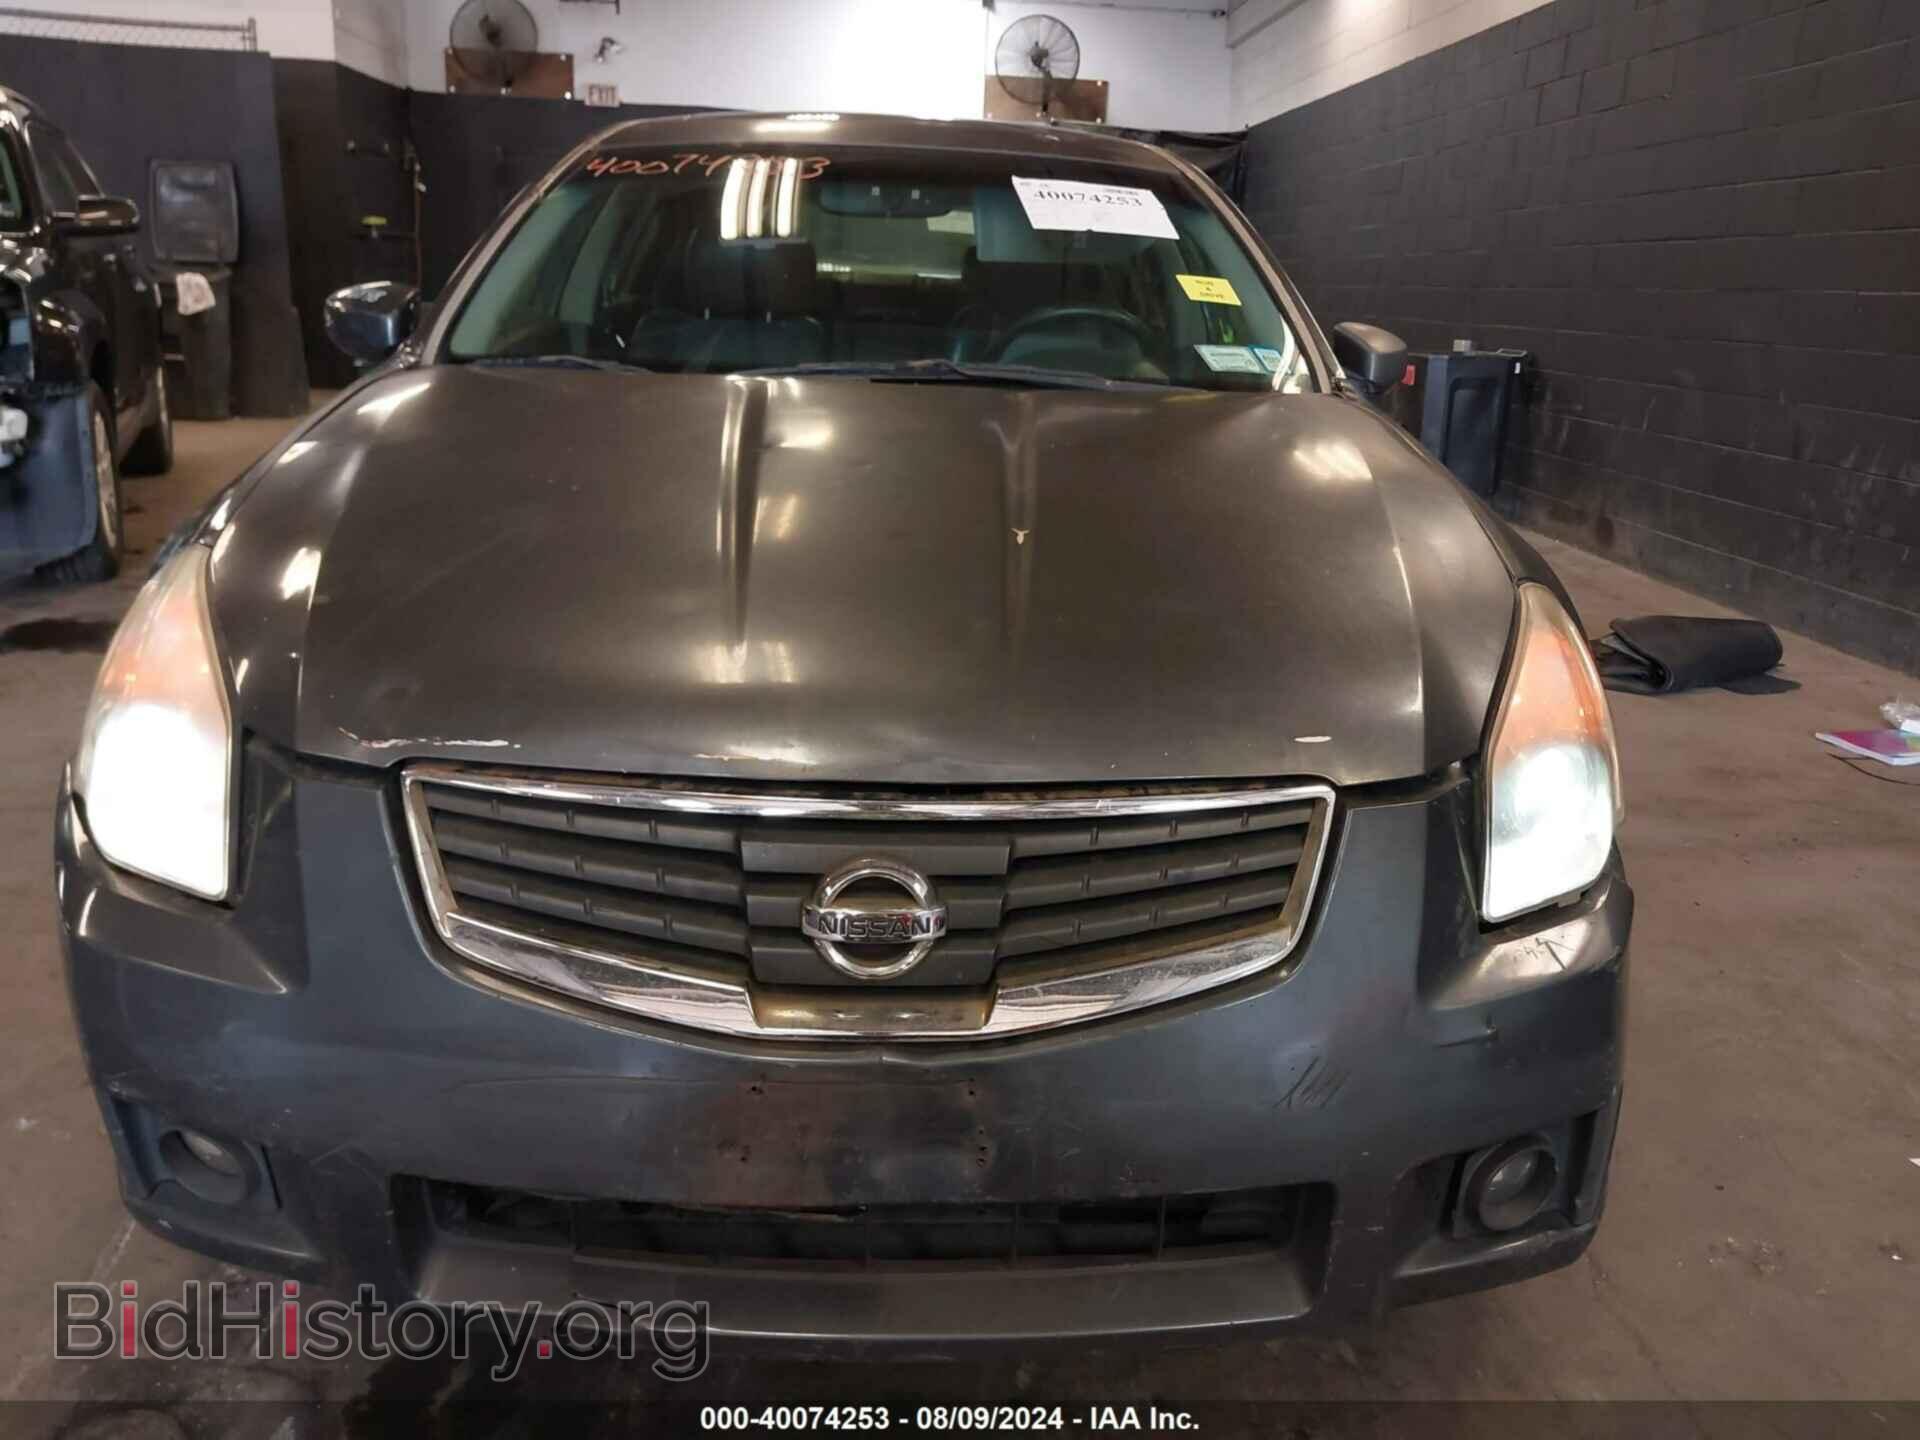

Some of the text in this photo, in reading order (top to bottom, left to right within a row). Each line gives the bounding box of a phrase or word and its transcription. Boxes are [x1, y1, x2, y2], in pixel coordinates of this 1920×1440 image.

[587, 153, 832, 179] 400743
[1034, 189, 1143, 207] 40074253
[817, 911, 934, 939] NISSAN
